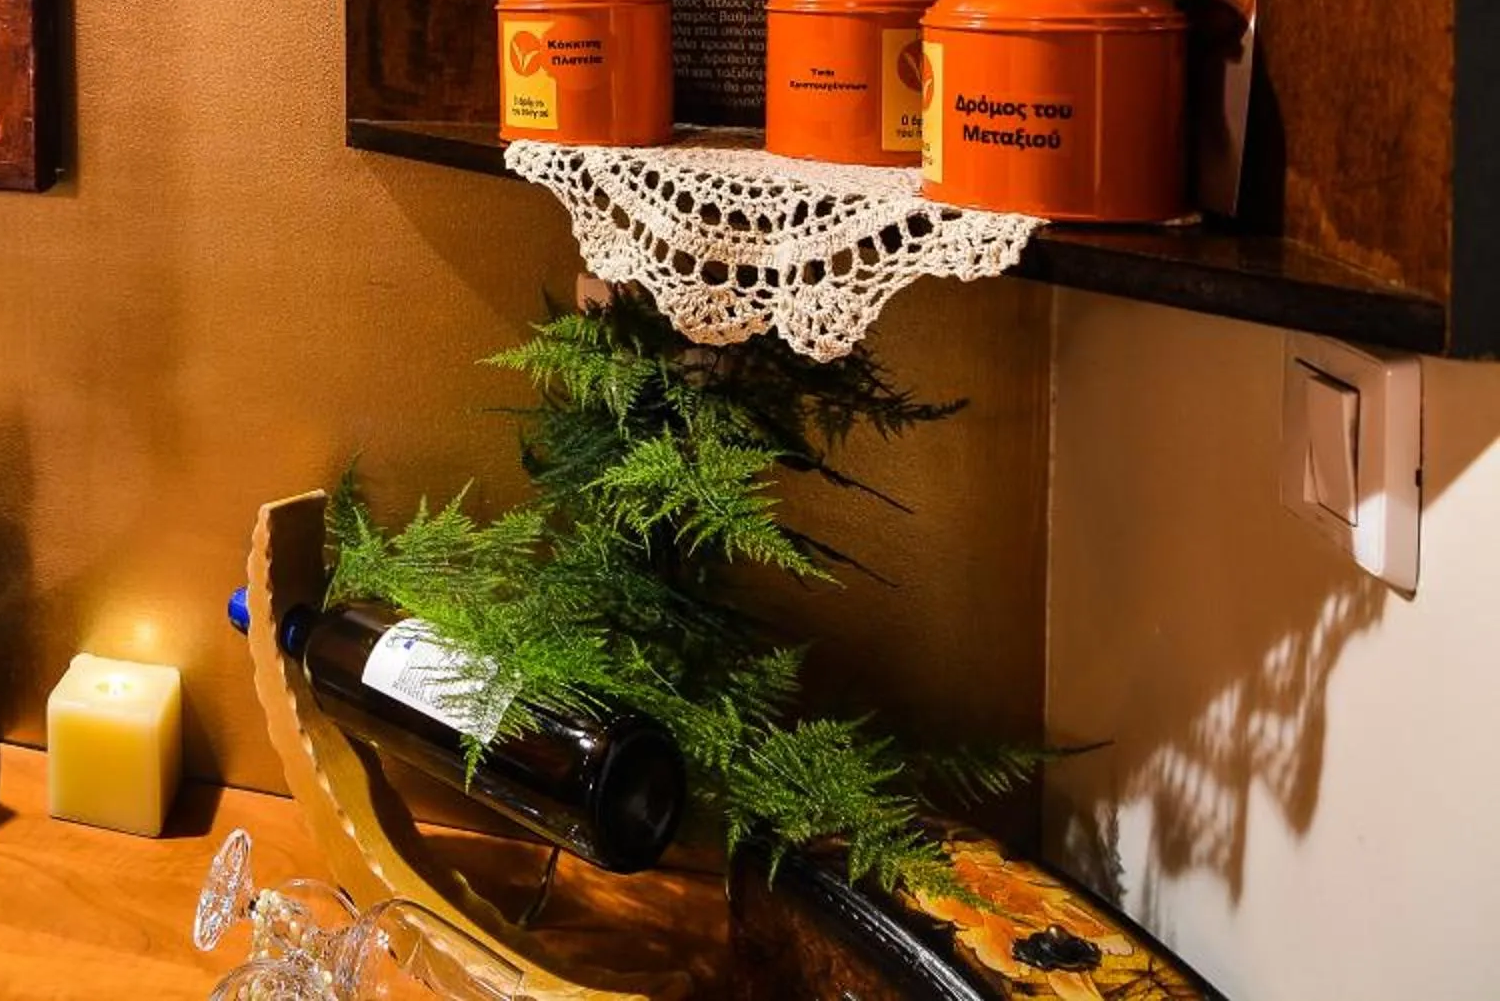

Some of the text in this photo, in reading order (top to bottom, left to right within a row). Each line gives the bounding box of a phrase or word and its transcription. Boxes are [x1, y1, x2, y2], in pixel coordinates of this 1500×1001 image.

[955, 94, 1073, 120] Δρόμος του
[963, 124, 1062, 150] Μεταξιού
